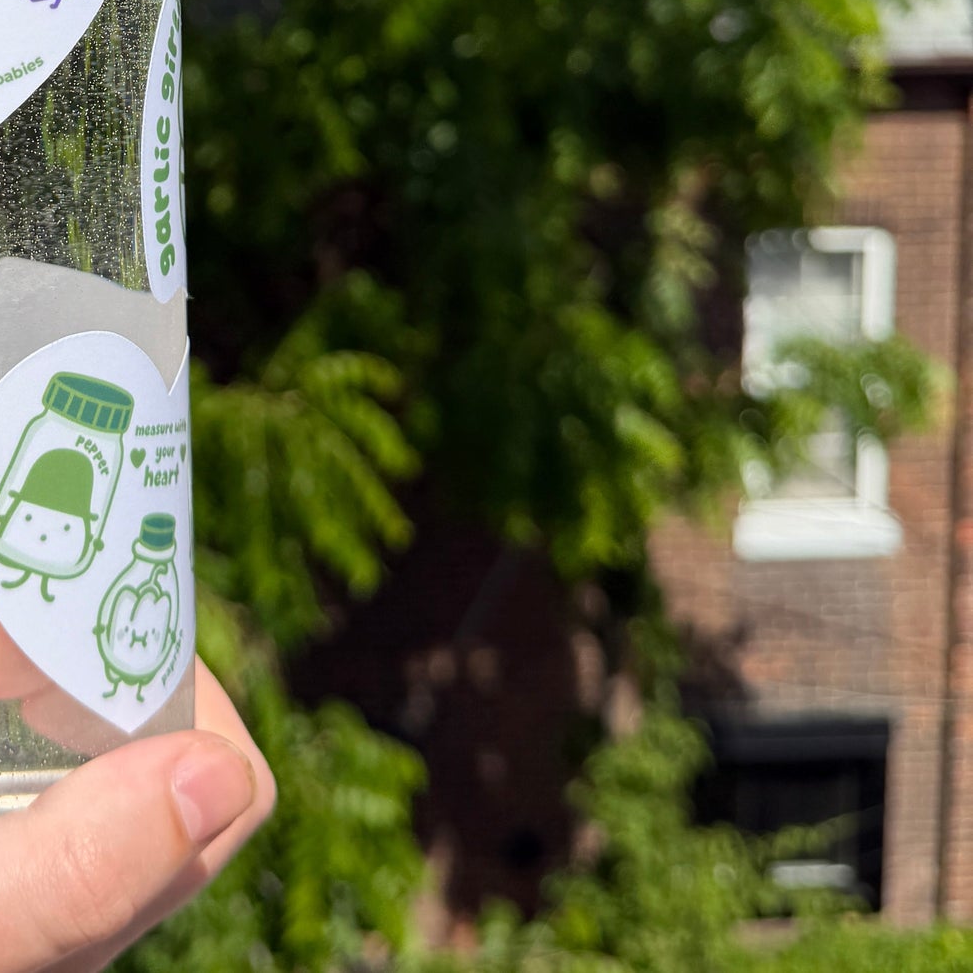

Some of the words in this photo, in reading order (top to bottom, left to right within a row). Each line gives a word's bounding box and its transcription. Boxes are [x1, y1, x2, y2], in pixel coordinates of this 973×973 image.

[153, 115, 176, 276] garlic
[135, 423, 174, 437] measure
[75, 434, 109, 476] pepper
[155, 446, 175, 464] your
[144, 462, 179, 487] heart
